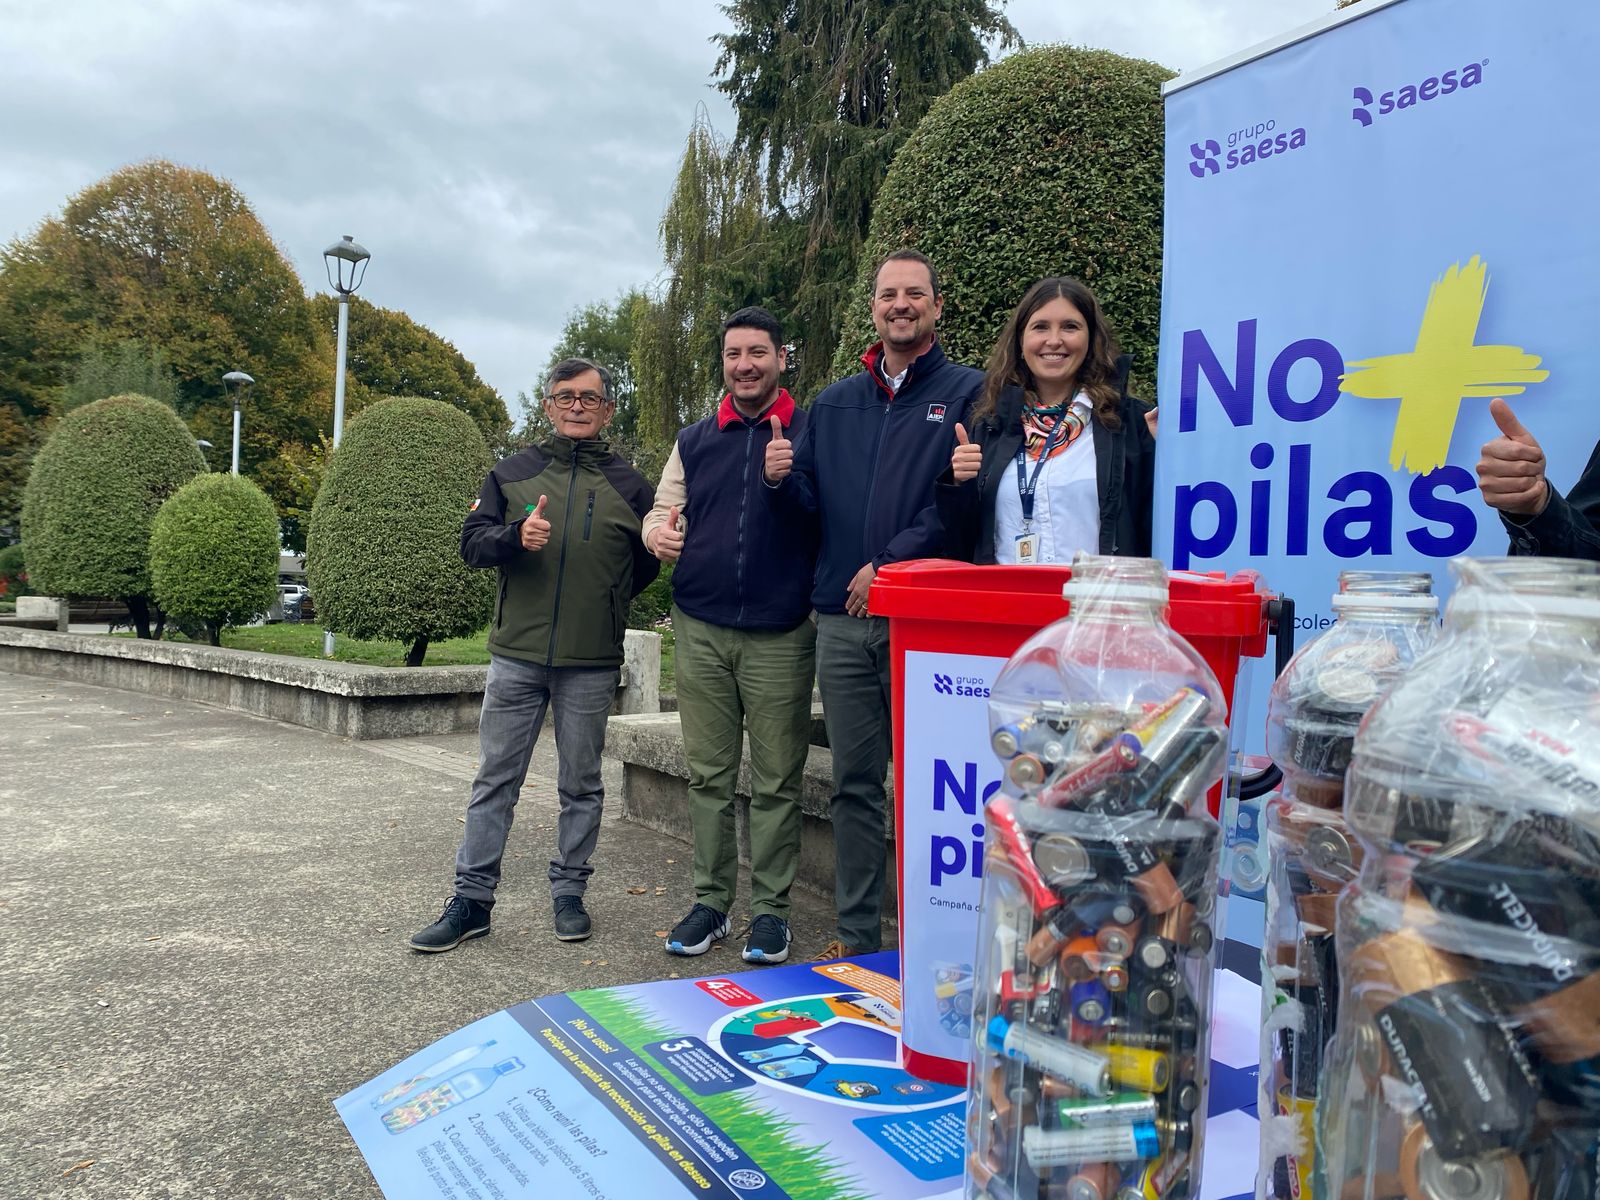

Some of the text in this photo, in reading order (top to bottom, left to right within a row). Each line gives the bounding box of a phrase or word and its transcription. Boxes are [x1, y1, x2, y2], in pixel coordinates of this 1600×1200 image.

[1228, 119, 1276, 148] grupo
[1226, 127, 1307, 169] saesa
[1179, 318, 1344, 433] No
[1172, 442, 1478, 570] pilas
[956, 676, 984, 686] grupo
[956, 685, 991, 698] saes
[930, 896, 973, 911] Campaña
[826, 965, 852, 974] 5
[706, 981, 731, 990] 4
[582, 1028, 597, 1039] las
[660, 1039, 694, 1052] 3
[598, 1081, 612, 1091] de
[606, 1088, 647, 1125] recolección
[632, 1066, 651, 1079] pilas
[654, 1084, 666, 1092] se
[700, 1126, 713, 1135] se
[707, 1134, 739, 1160] pueden
[468, 1113, 481, 1124] 2.
[526, 1087, 608, 1157] ¿Cómo reunir las pilas?
[637, 1086, 657, 1099] para
[653, 1098, 675, 1114] evitar
[669, 1113, 686, 1126] que
[682, 1125, 724, 1163] contaminen
[442, 1124, 456, 1135] 3.
[506, 1096, 518, 1106] 1.
[569, 1164, 582, 1175] de
[641, 1124, 657, 1135] de
[648, 1133, 674, 1151] pilas
[668, 1150, 684, 1161] en
[679, 1160, 712, 1189] desuso
